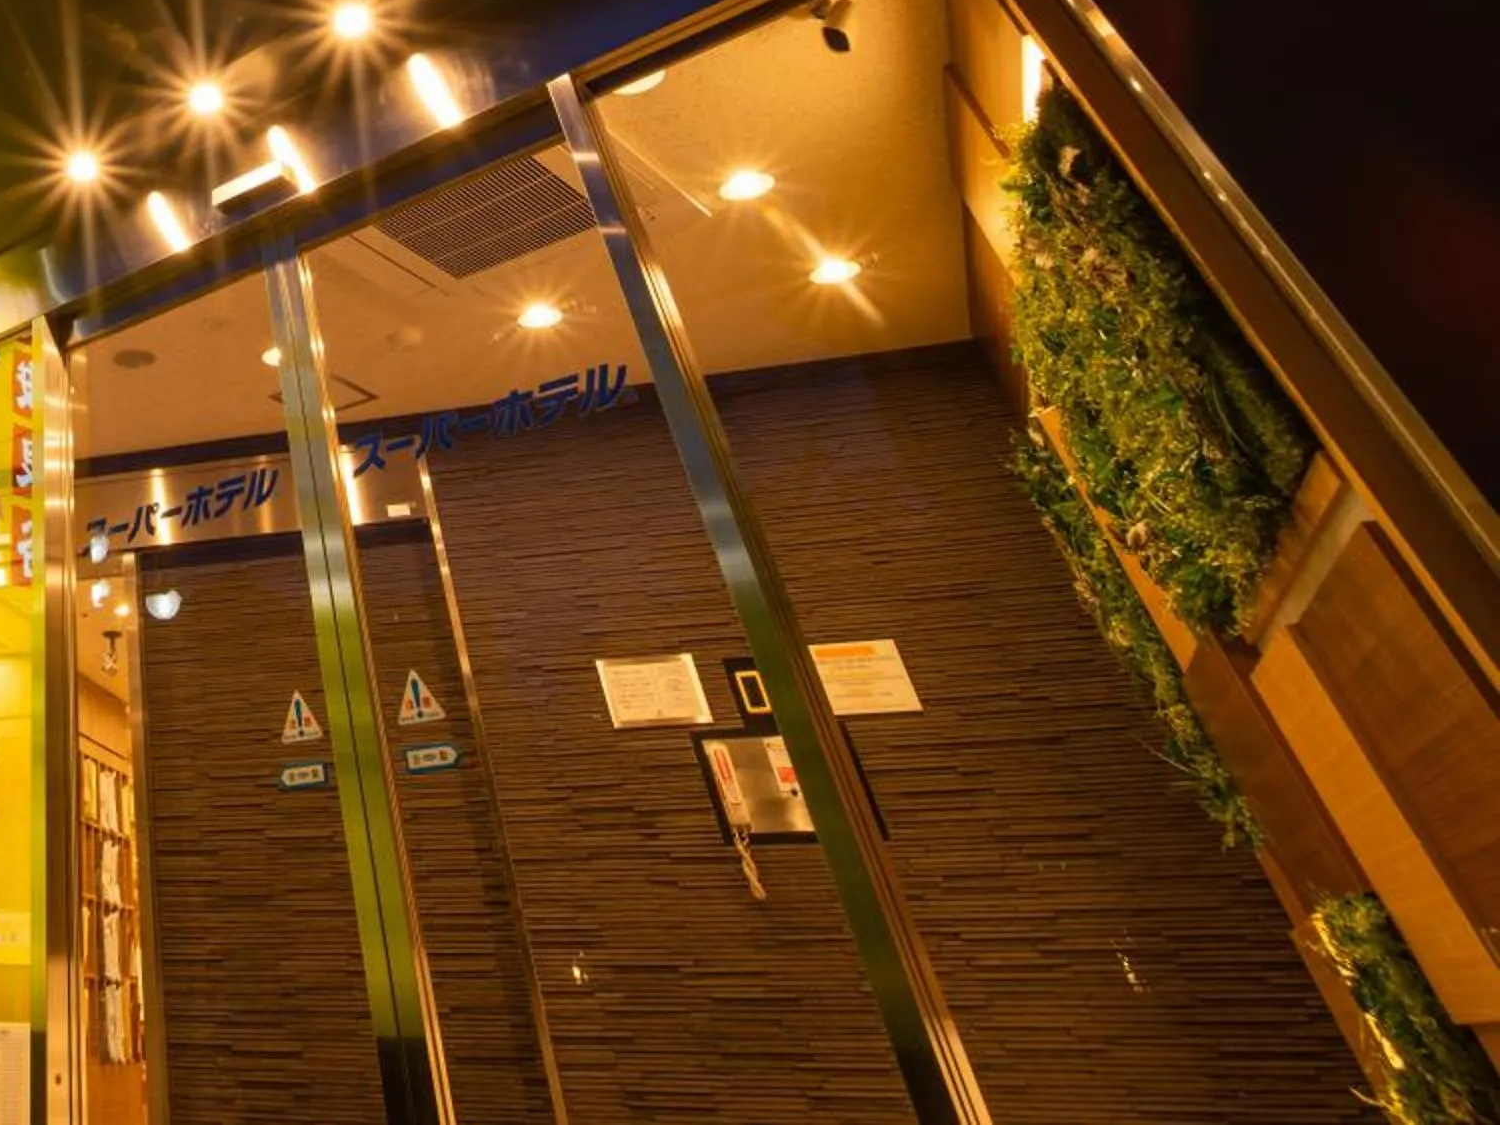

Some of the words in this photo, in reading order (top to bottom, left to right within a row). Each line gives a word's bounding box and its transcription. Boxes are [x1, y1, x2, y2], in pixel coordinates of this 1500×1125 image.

[352, 363, 628, 479] スーパーホテル
